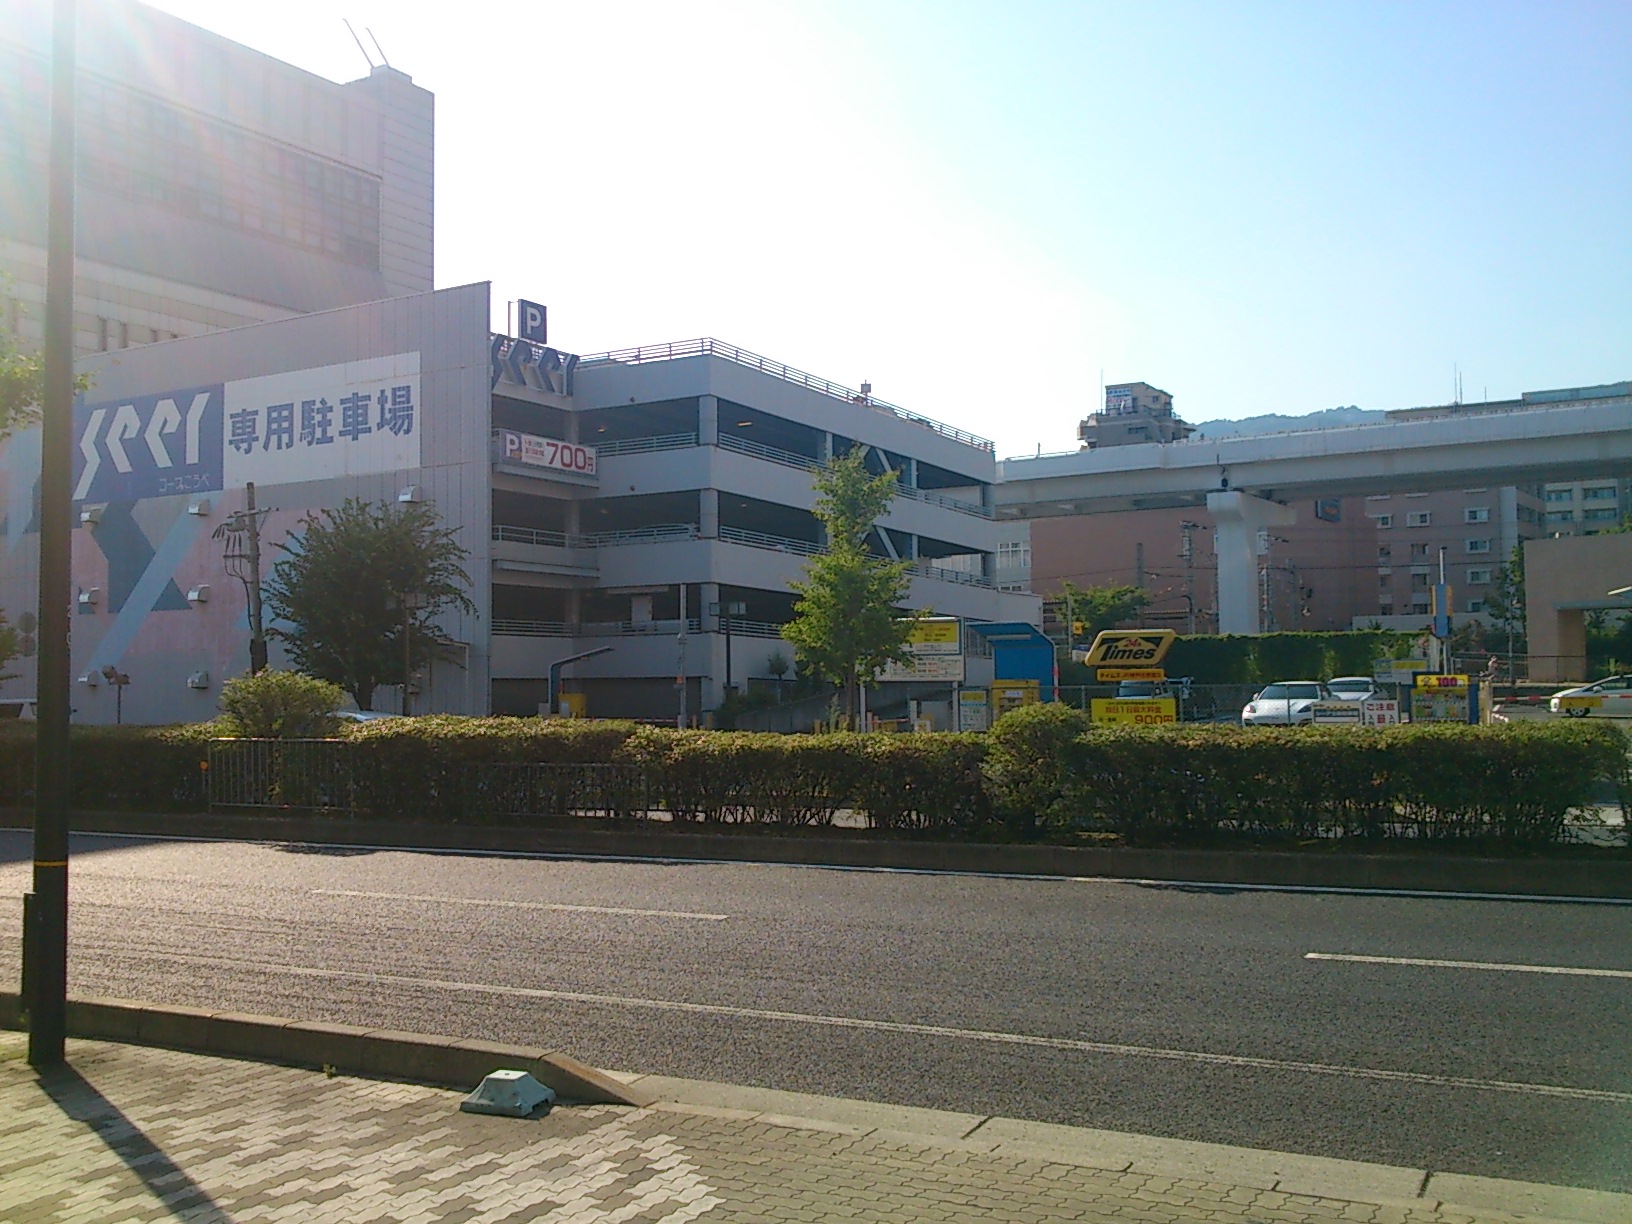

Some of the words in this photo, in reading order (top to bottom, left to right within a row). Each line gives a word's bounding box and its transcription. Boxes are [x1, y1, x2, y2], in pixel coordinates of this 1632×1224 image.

[526, 306, 542, 335] P
[228, 385, 415, 455] 専用駐車場
[505, 433, 520, 458] P
[1100, 644, 1157, 662] Times
